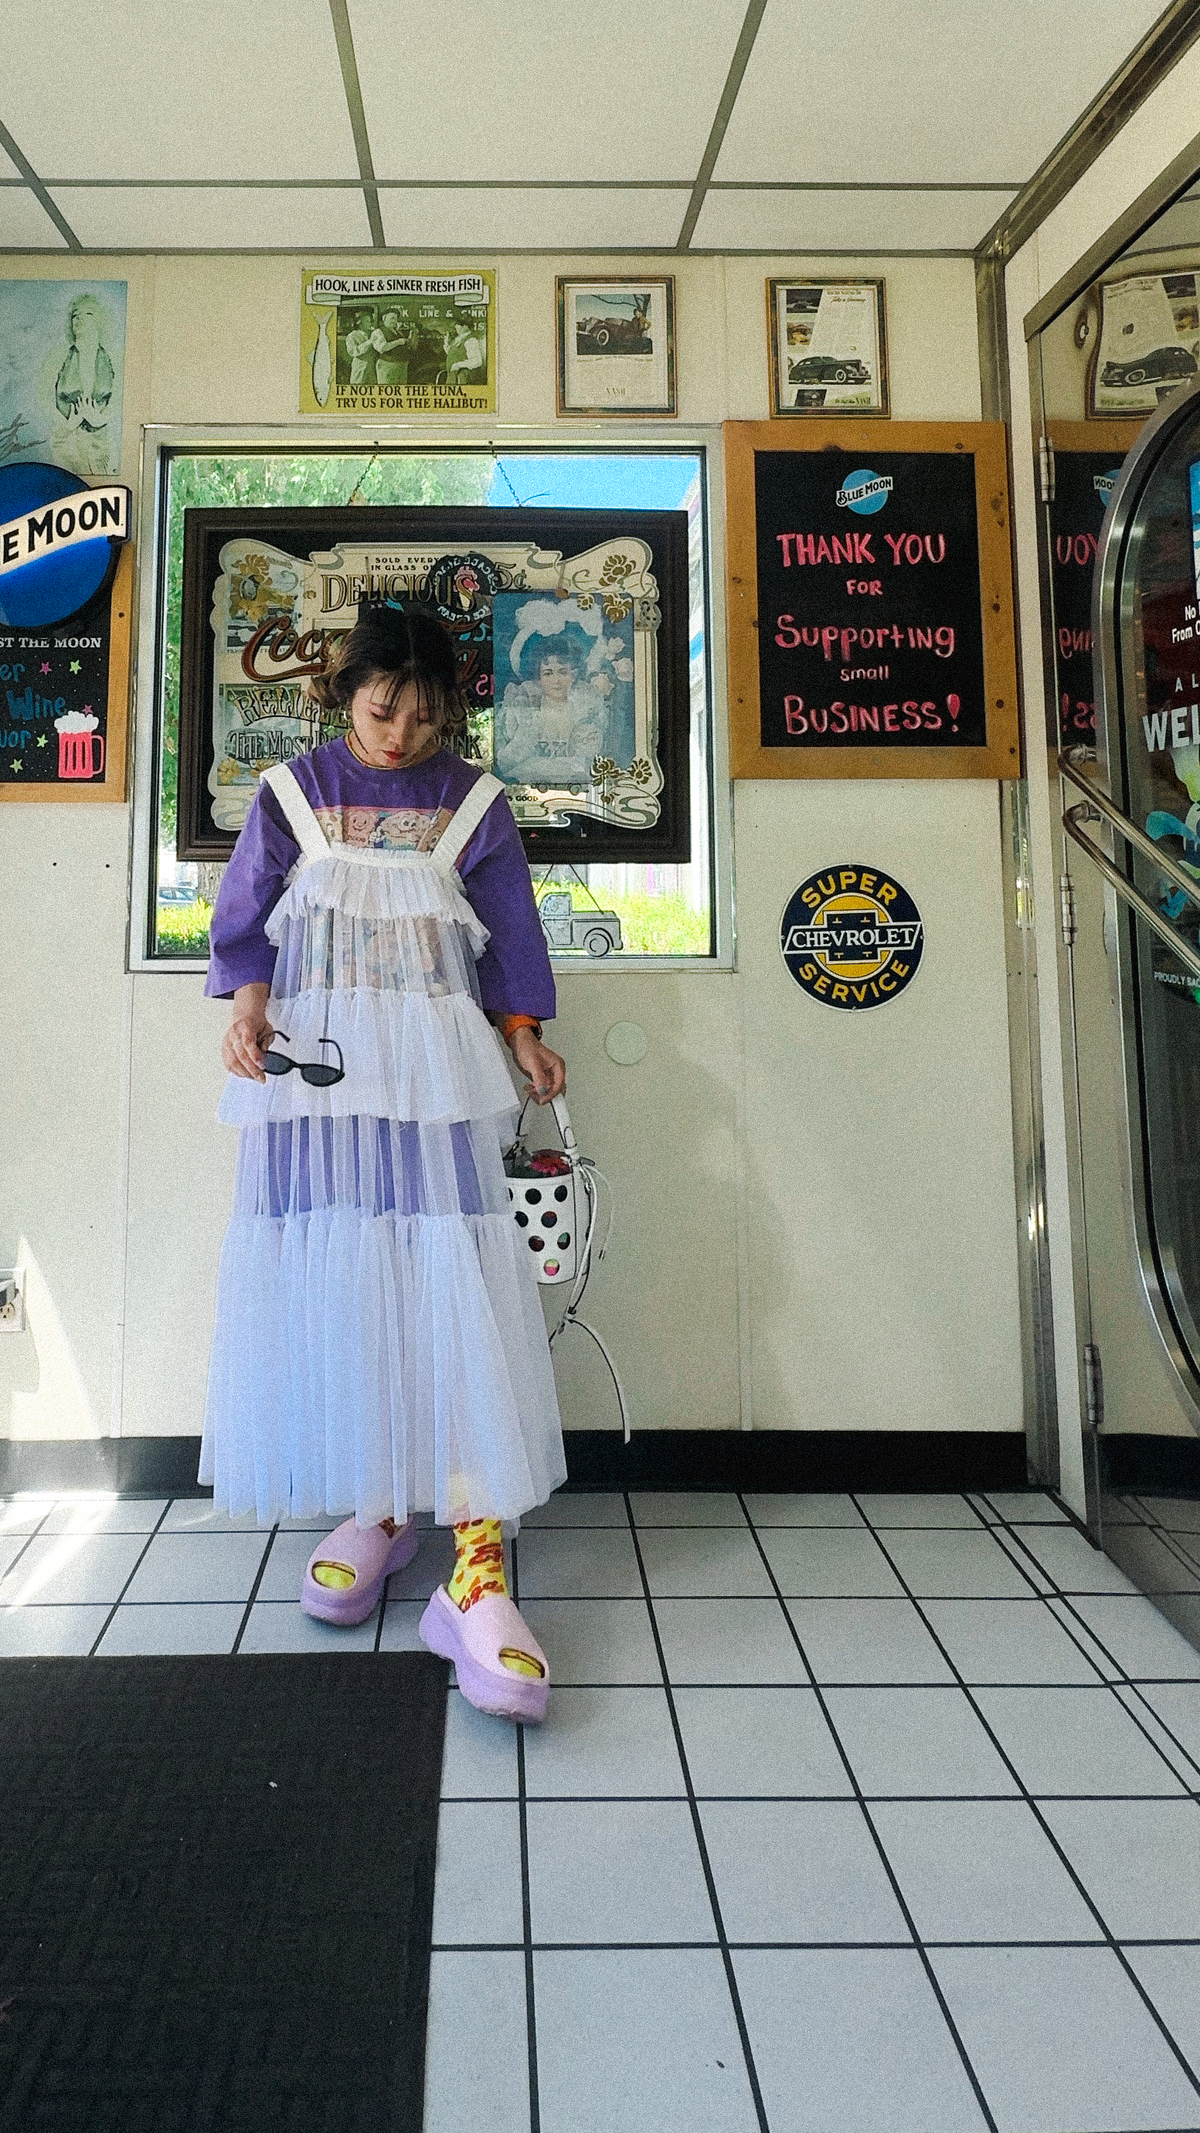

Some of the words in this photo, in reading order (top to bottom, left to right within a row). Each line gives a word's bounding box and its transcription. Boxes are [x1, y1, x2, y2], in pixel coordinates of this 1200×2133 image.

[315, 278, 350, 293] HOOK,
[352, 279, 375, 292] LINE
[377, 279, 385, 291] &
[387, 278, 423, 292] SINKER
[425, 279, 456, 293] FRESH
[458, 278, 481, 291] FISH
[335, 385, 347, 396] IF
[349, 385, 374, 396] NOT
[377, 385, 401, 396] FOR
[404, 385, 429, 396] THE
[431, 385, 467, 398] TUNA,
[335, 398, 358, 409] TRY
[361, 398, 377, 409] US
[380, 398, 403, 409] FOR
[406, 398, 431, 409] THE
[433, 398, 488, 409] HALIBUT!
[837, 487, 864, 505] BLUE
[864, 478, 892, 495] MOON
[27, 496, 120, 553] MOON
[776, 532, 876, 568] THANK
[883, 532, 947, 566] YOU
[320, 573, 478, 612] DELICIOUS
[846, 579, 884, 596] FOR
[1184, 604, 1197, 621] No
[19, 637, 50, 648] THE
[54, 637, 102, 648] MOON
[1171, 625, 1194, 643] From
[840, 665, 890, 682] small
[6, 686, 67, 721] Wine
[227, 729, 264, 760] THE
[515, 794, 539, 802] GOOD
[801, 871, 898, 909] SUPER
[792, 927, 915, 948] CHEVROLET
[798, 959, 910, 1003] SERVICE
